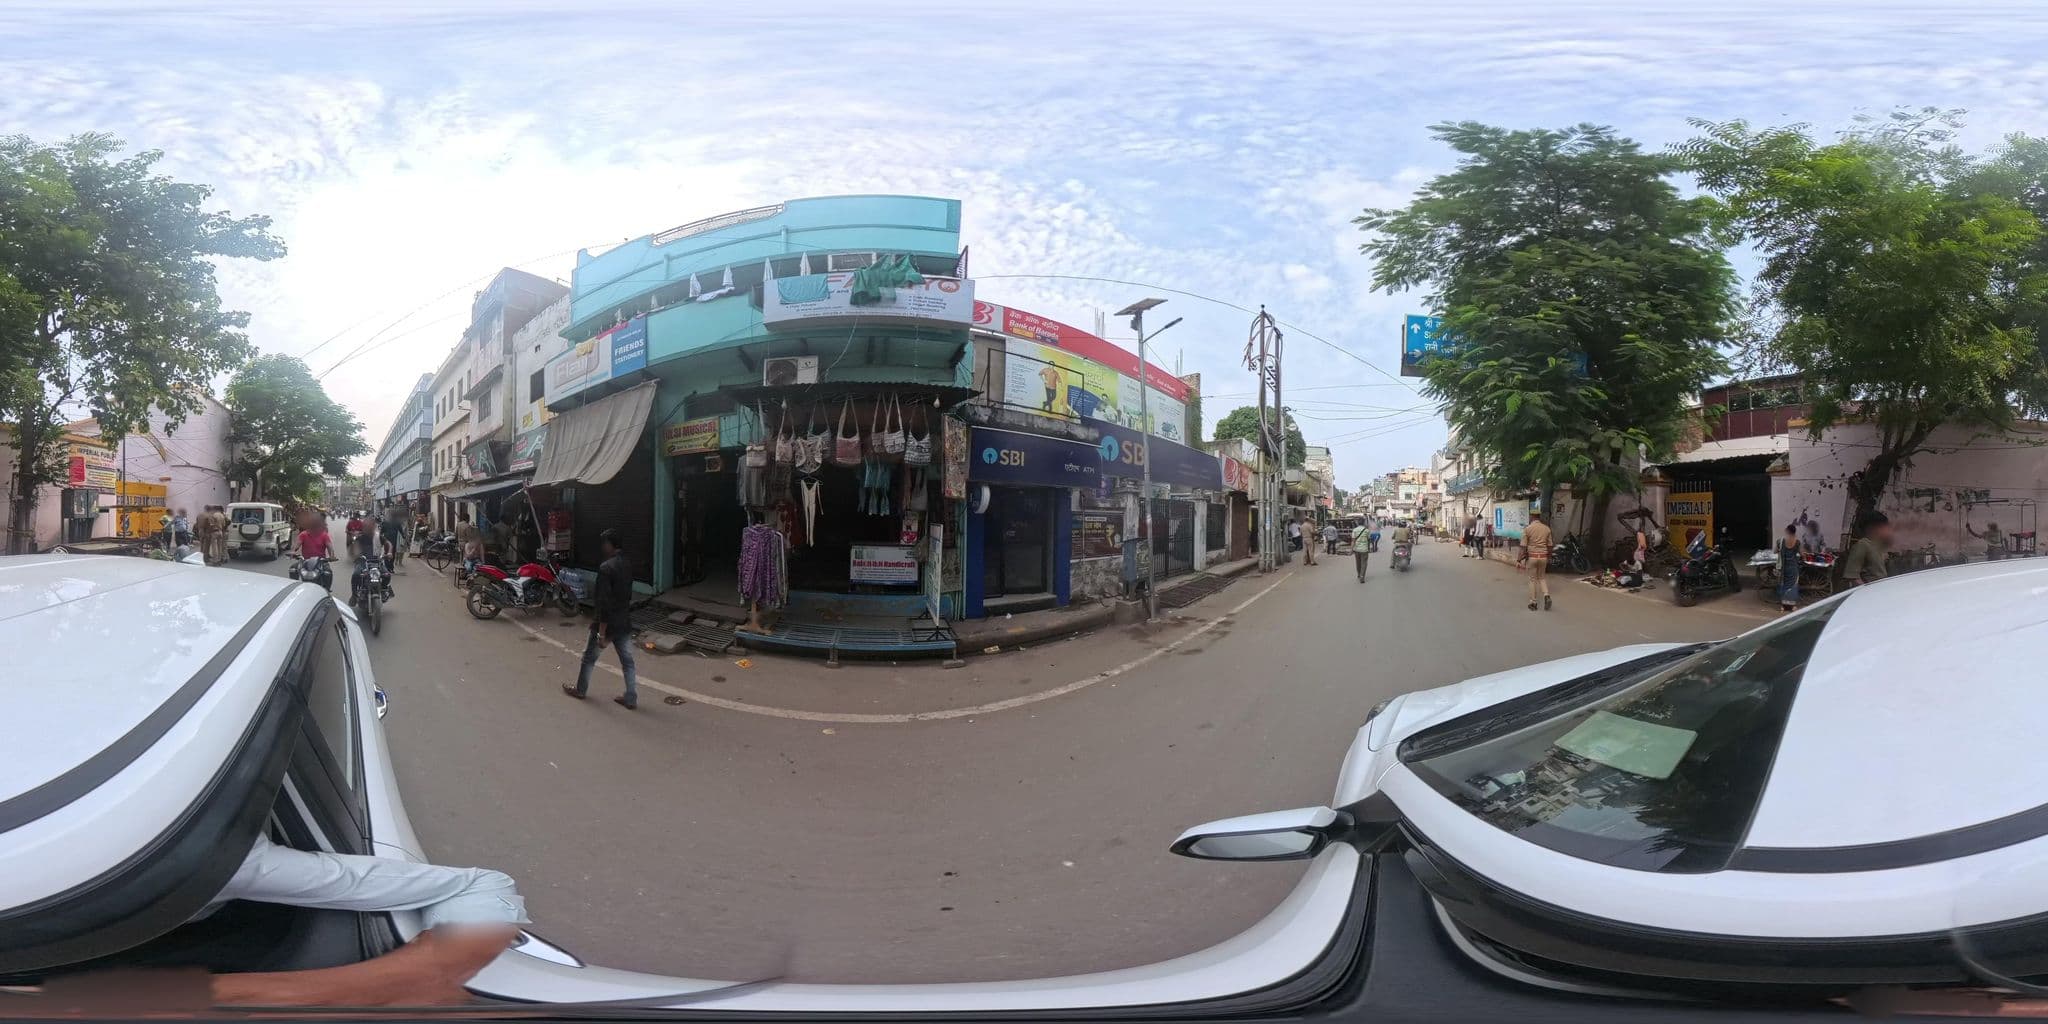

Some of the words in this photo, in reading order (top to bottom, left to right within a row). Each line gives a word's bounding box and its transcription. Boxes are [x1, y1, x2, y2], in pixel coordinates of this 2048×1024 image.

[1009, 319, 1028, 330] Bank
[1036, 327, 1059, 339] Baroda
[615, 339, 644, 357] FRIENDS
[615, 350, 644, 365] STATIONERY
[1000, 450, 1025, 467] SBI
[1121, 440, 1145, 466] SB
[1083, 466, 1095, 474] ATM
[1667, 501, 1704, 515] IMPERIAL
